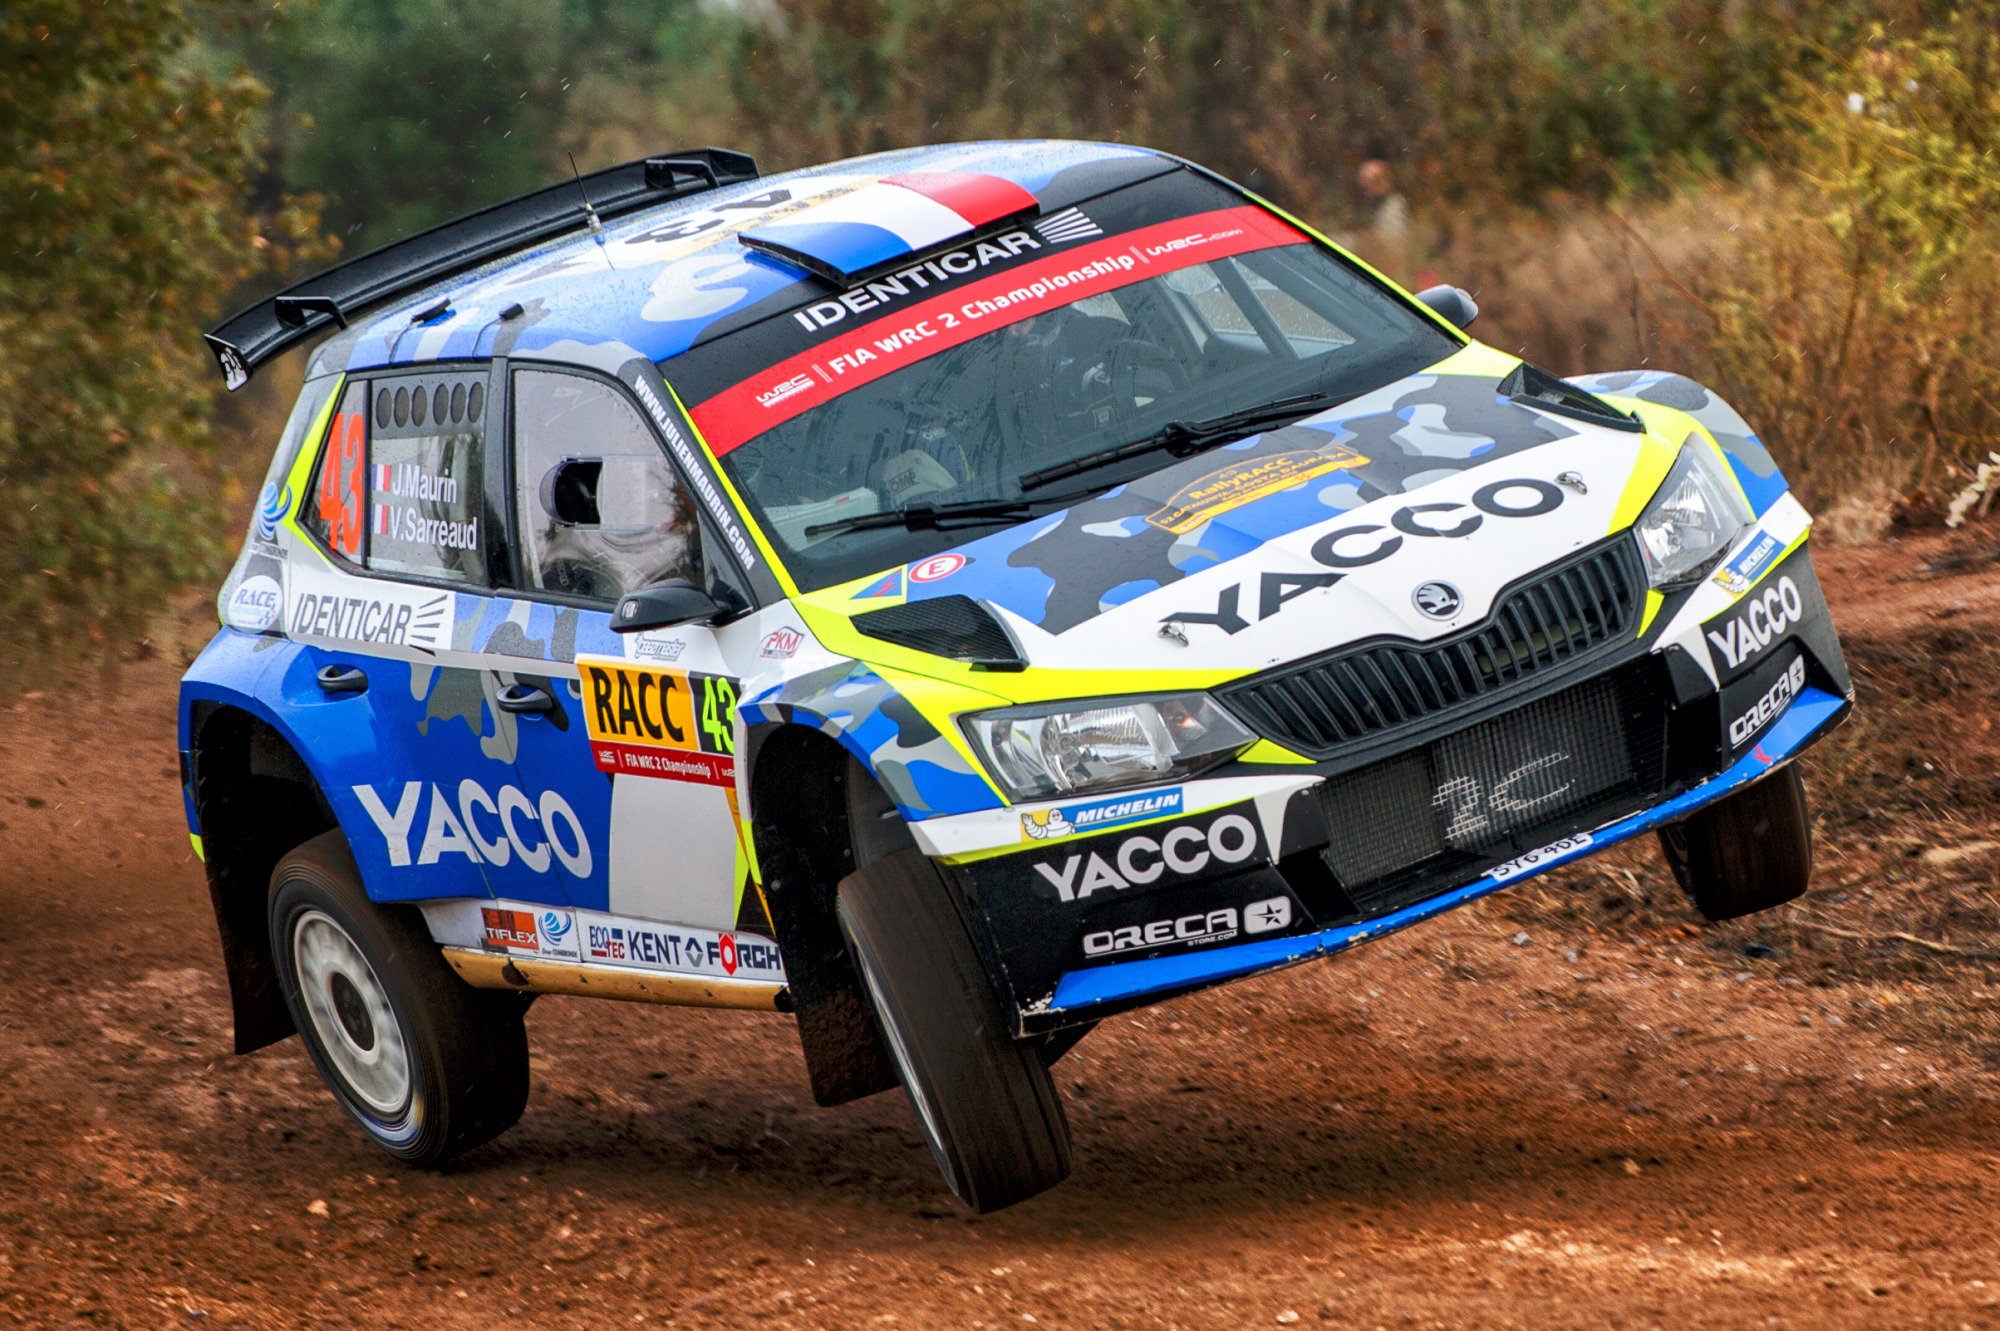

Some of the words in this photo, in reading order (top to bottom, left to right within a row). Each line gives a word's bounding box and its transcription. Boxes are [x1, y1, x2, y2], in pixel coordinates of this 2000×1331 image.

[794, 231, 1042, 332] IDENTICAR
[828, 346, 878, 375] FIA
[874, 320, 938, 354] WRC
[937, 312, 961, 329] 2
[960, 245, 1137, 320] Championship
[320, 413, 365, 555] 43
[391, 462, 458, 504] J.Maurin
[634, 374, 755, 571] WWW.JULIENMAURIN.COM
[1188, 456, 1294, 500] RallyRACC
[390, 506, 478, 550] V.Sarreaud
[1158, 477, 1565, 637] YACCO
[1738, 535, 1776, 575] MICHELIN
[234, 588, 278, 608] RACE
[291, 593, 411, 645] IDENTICAR
[764, 630, 801, 648] PKM
[1707, 575, 1803, 669] YACCO
[588, 666, 685, 743] RACC
[702, 676, 737, 755] 43
[1729, 671, 1791, 747] ORECA
[625, 752, 639, 767] FIA
[638, 754, 656, 770] WRC
[655, 756, 662, 770] 2
[661, 757, 712, 779] Championship
[351, 778, 594, 879] YACCO
[1075, 793, 1181, 824] MICHELIN
[1034, 814, 1257, 902] YACCO
[486, 927, 538, 944] TIFLEX
[588, 925, 610, 949] ECO
[606, 940, 625, 960] TEC
[626, 930, 682, 966] KENT
[1082, 907, 1238, 955] ORECA
